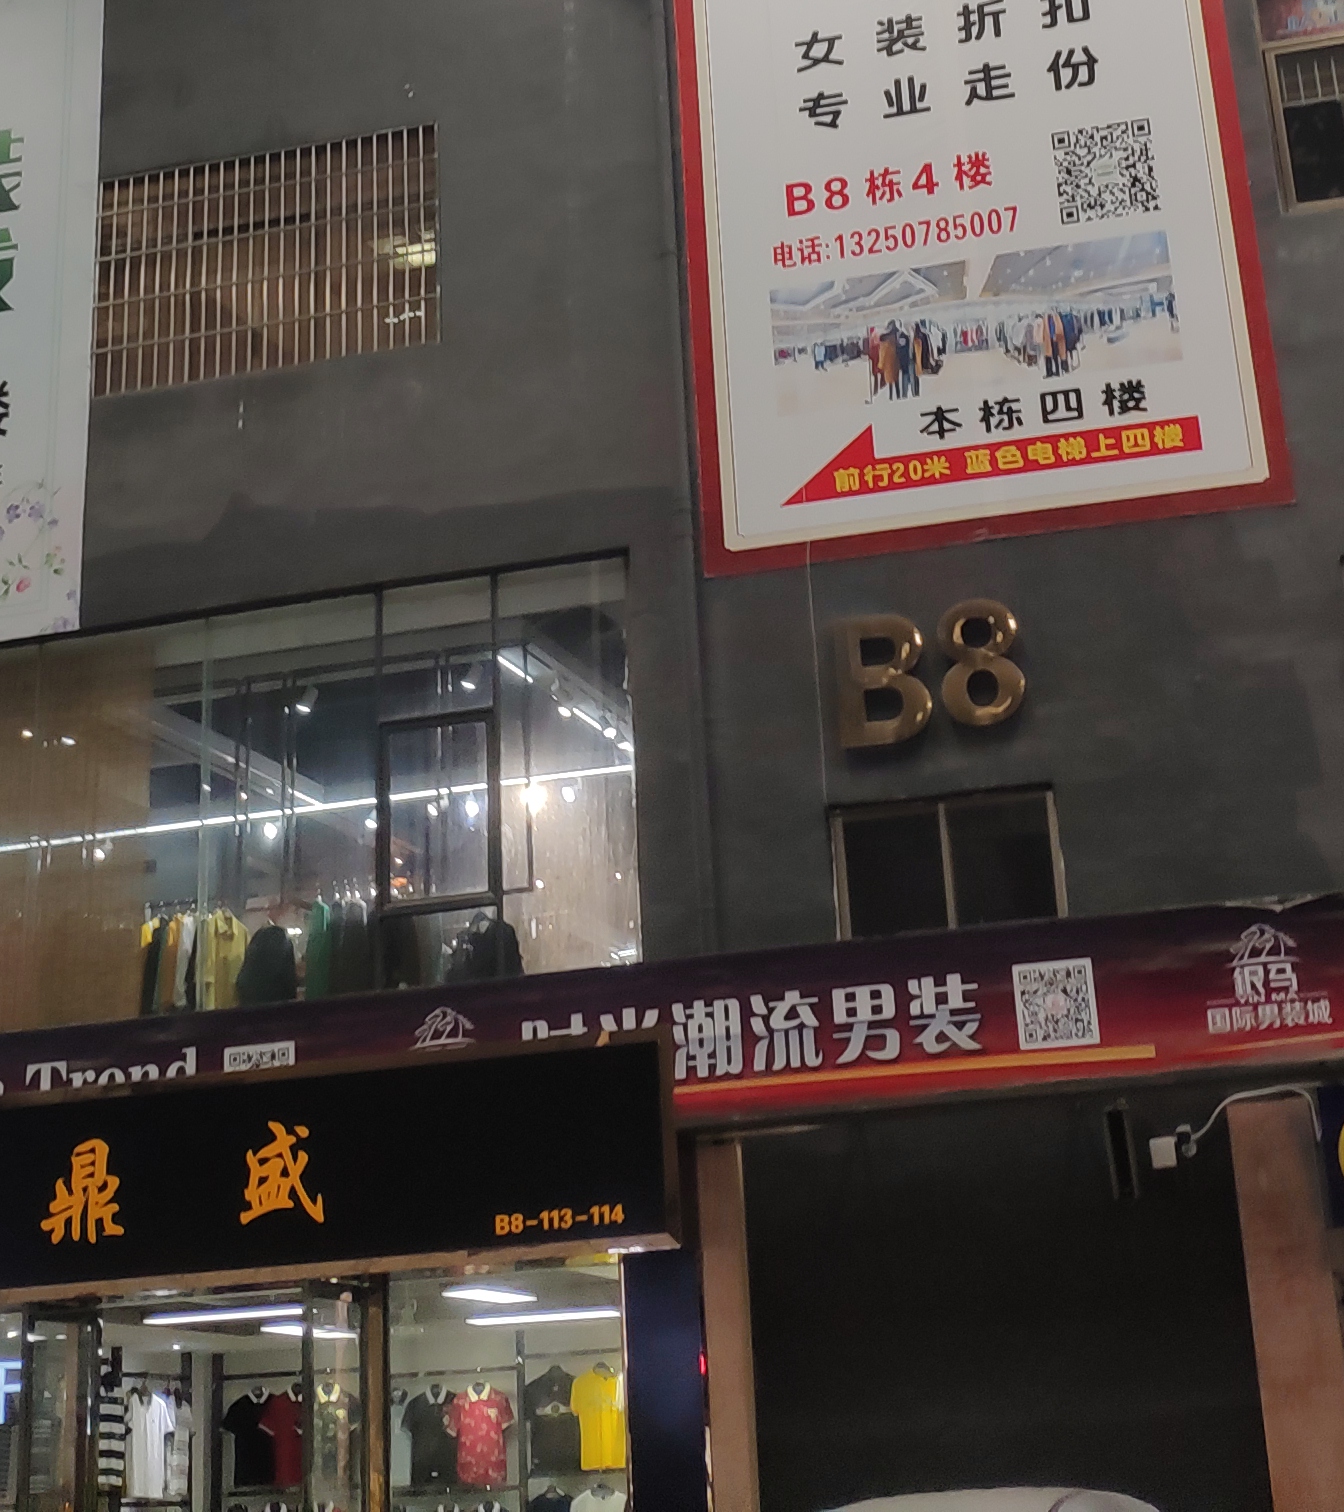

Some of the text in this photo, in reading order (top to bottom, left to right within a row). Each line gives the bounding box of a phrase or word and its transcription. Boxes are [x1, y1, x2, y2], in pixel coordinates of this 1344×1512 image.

[798, 44, 1099, 130] 专业走份
[919, 378, 1148, 440] 本栋四楼
[834, 597, 1026, 749] B8
[521, 972, 982, 1080] 潮流男装
[1207, 998, 1333, 1034] 国际男装城
[494, 1203, 625, 1236] B8-113-114
